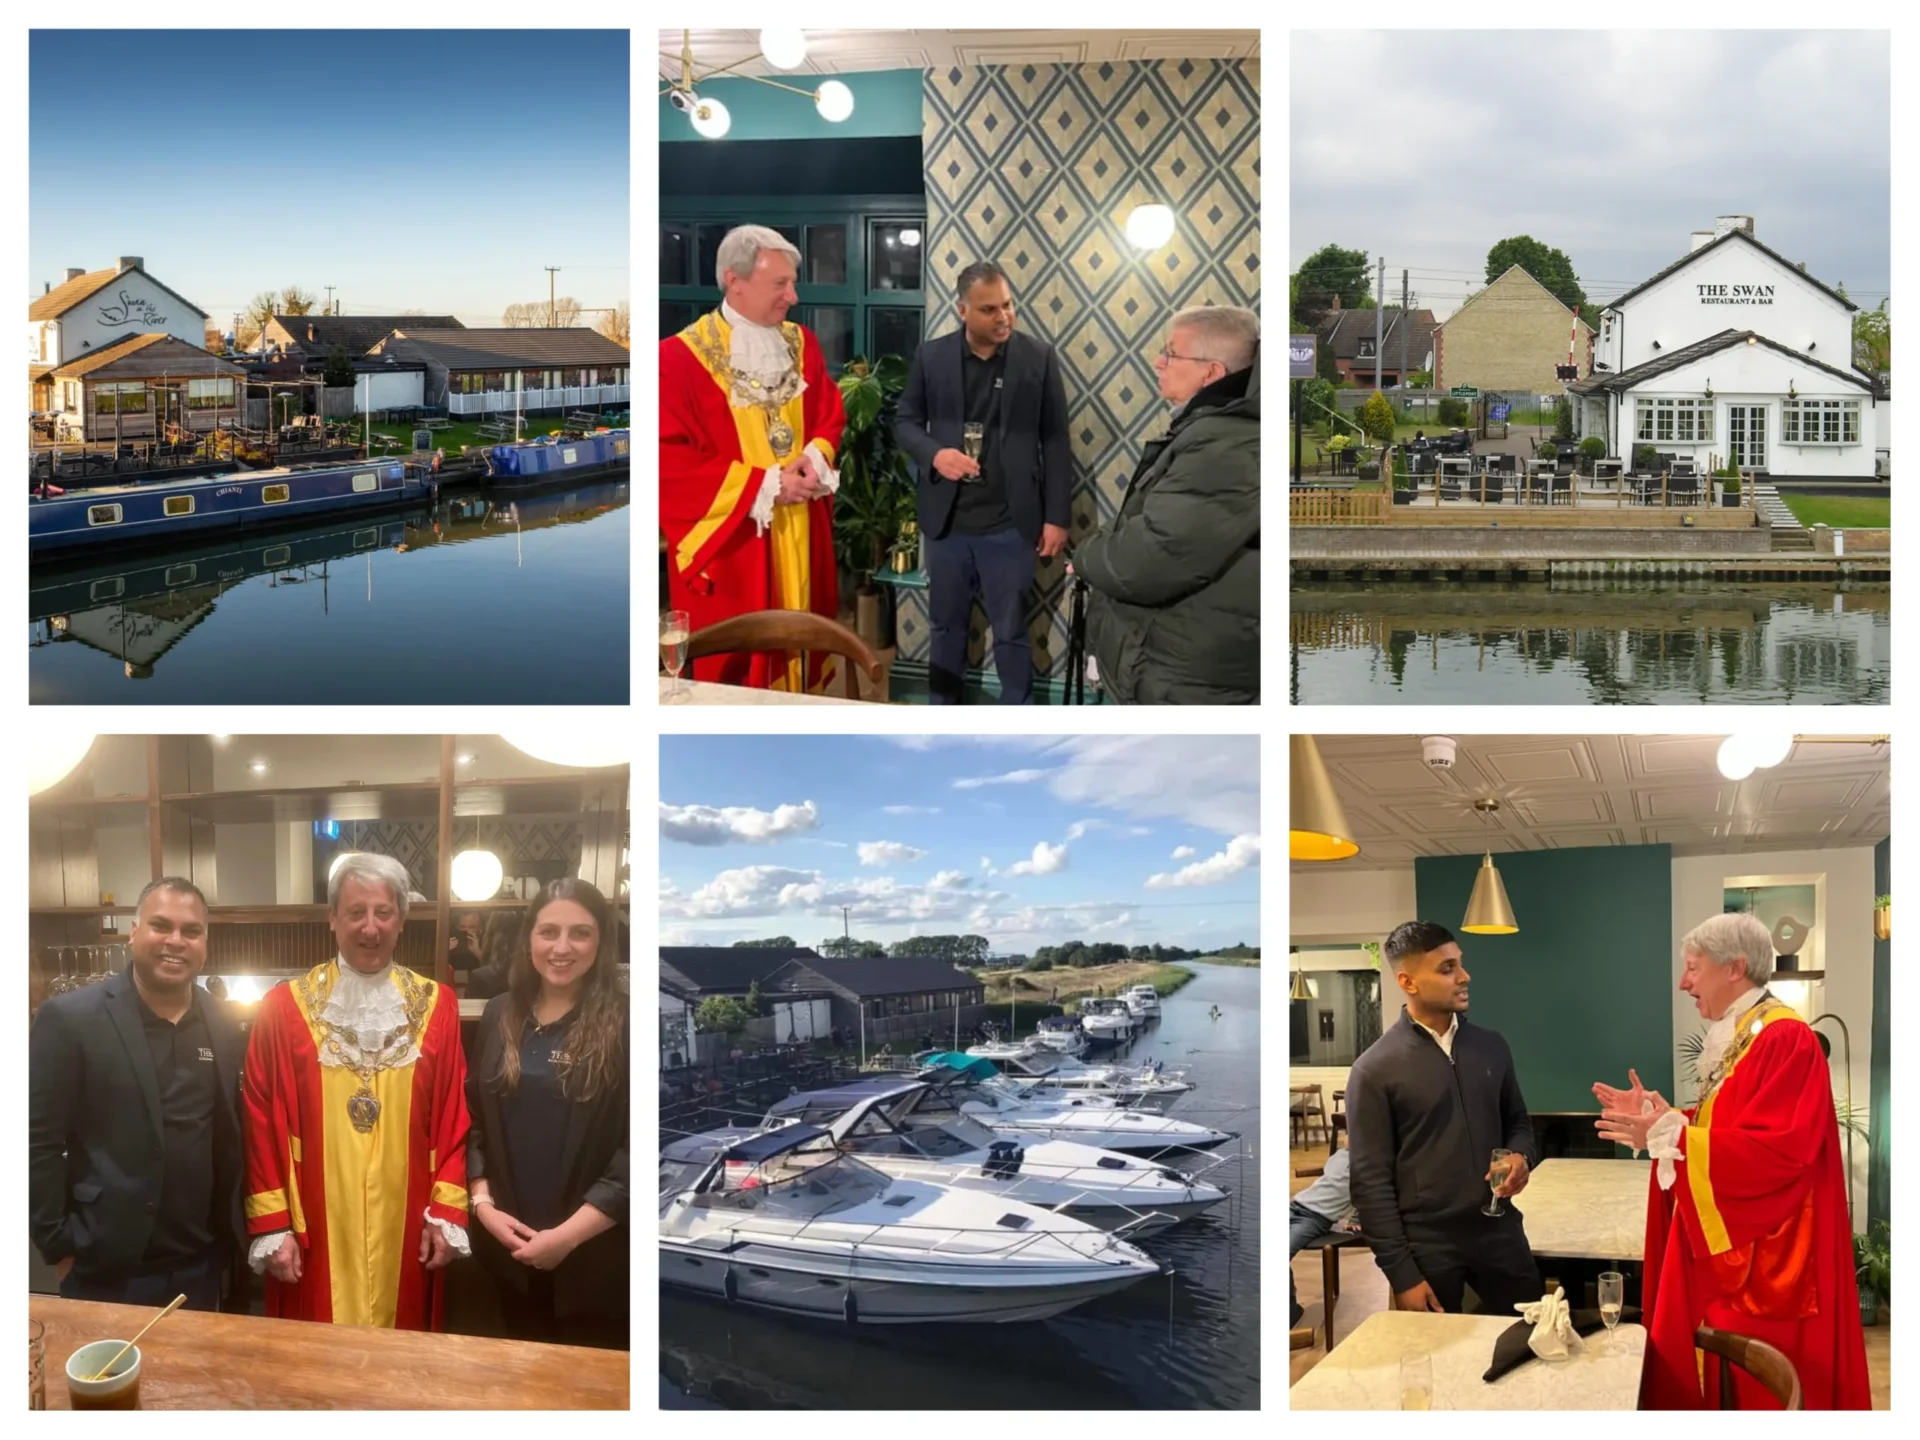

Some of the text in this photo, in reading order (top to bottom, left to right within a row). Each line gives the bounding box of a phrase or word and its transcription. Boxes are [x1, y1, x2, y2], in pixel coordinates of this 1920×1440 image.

[1696, 284, 1775, 296] THE SWAN
[1700, 297, 1750, 305] RESTAURANT
[142, 312, 168, 327] River
[215, 486, 243, 497] CHIANTI
